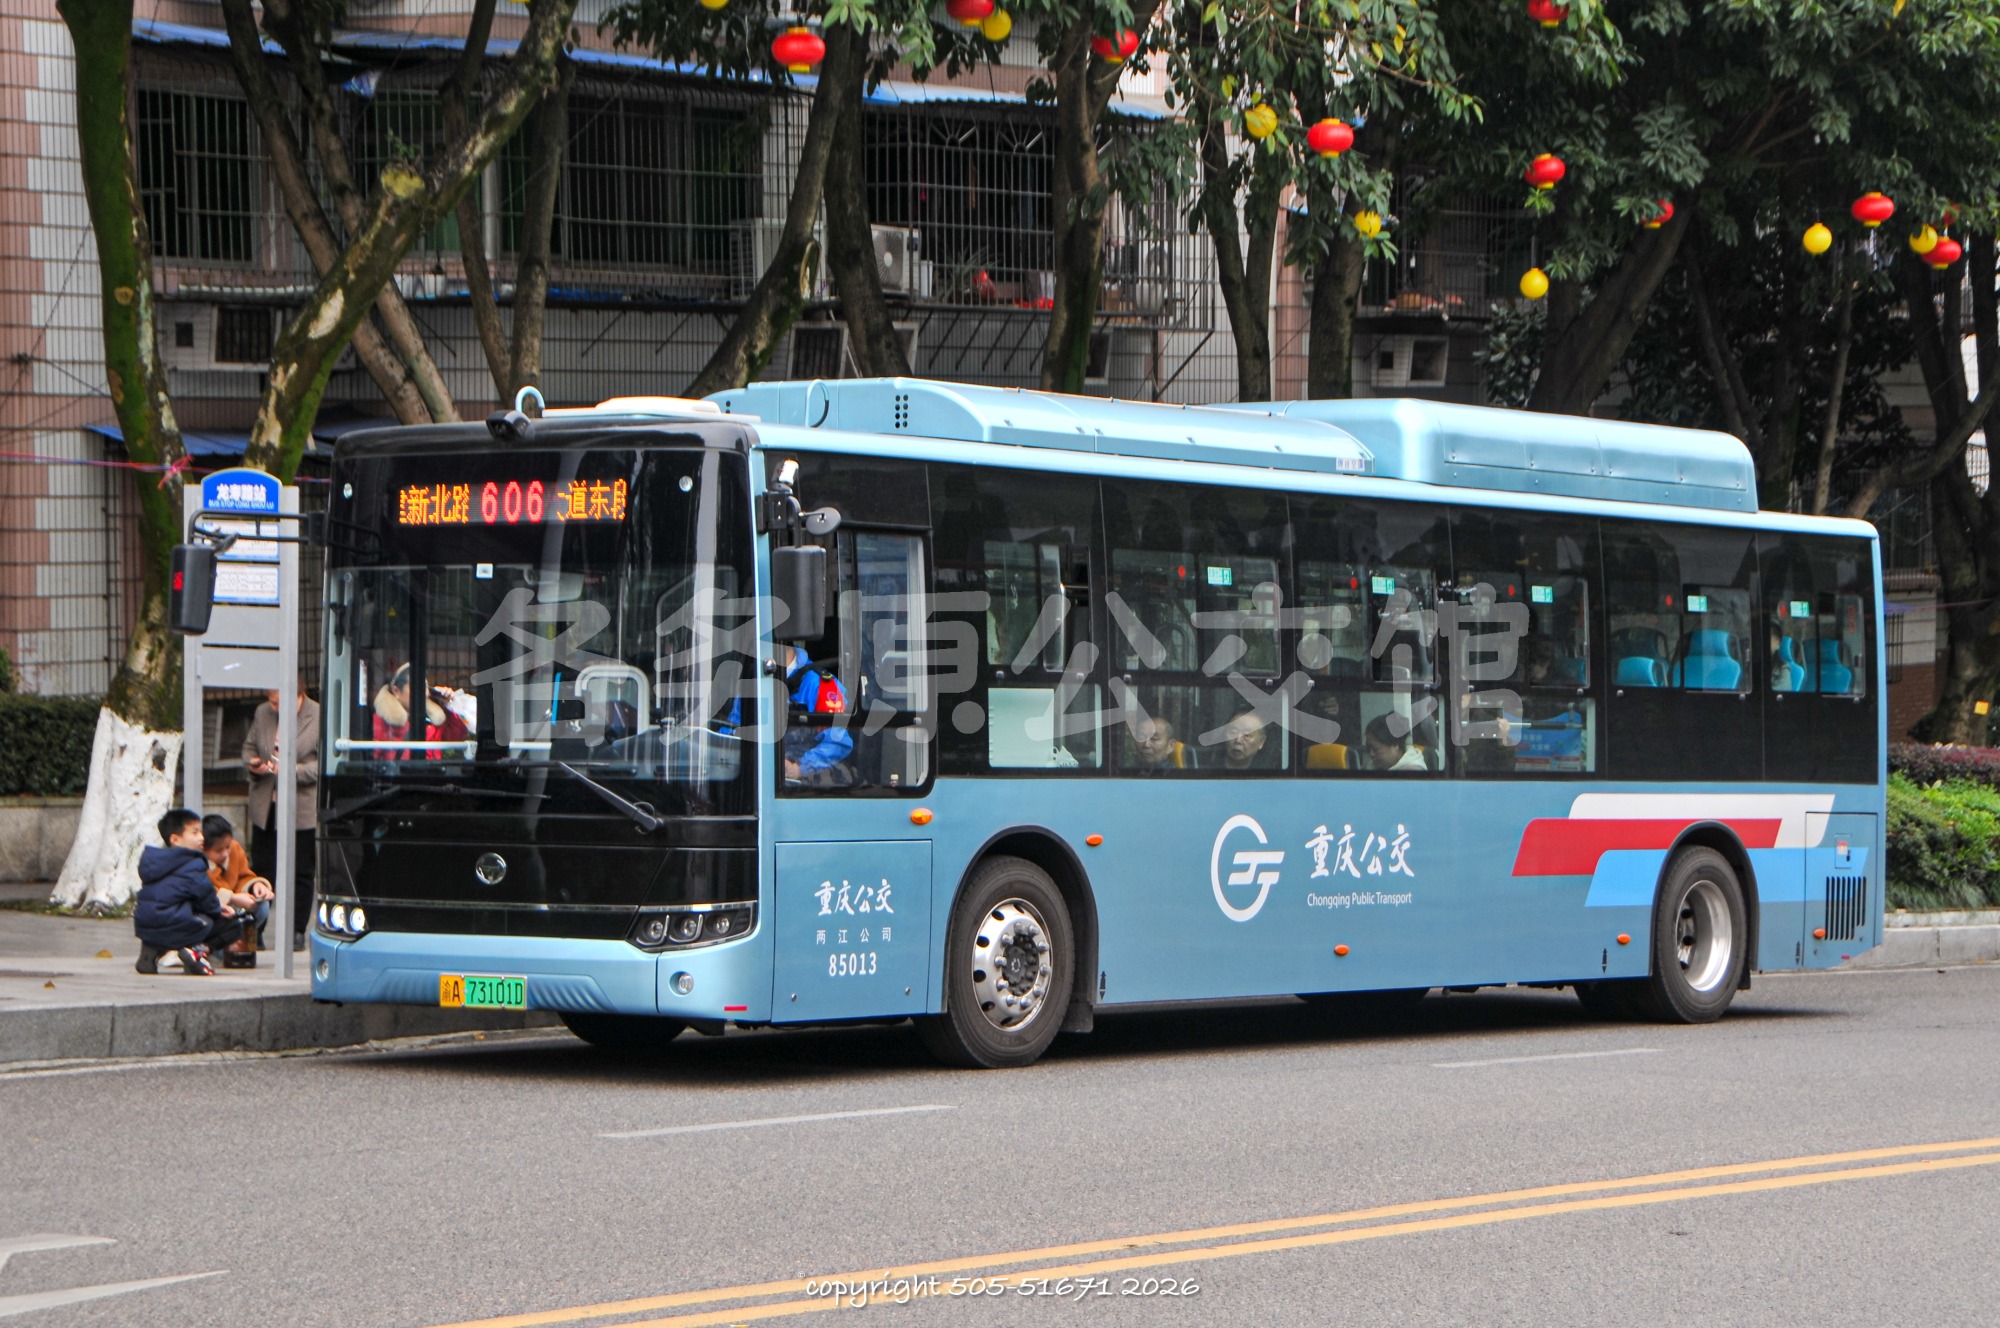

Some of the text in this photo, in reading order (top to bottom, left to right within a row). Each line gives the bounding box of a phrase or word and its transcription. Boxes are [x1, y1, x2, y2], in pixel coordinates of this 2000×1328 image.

[482, 481, 543, 523] 606
[1305, 824, 1415, 879] 重庆公交
[814, 878, 895, 916] 重庆公交
[1307, 891, 1412, 909] Chongqing Public Transport
[828, 952, 877, 976] 85013
